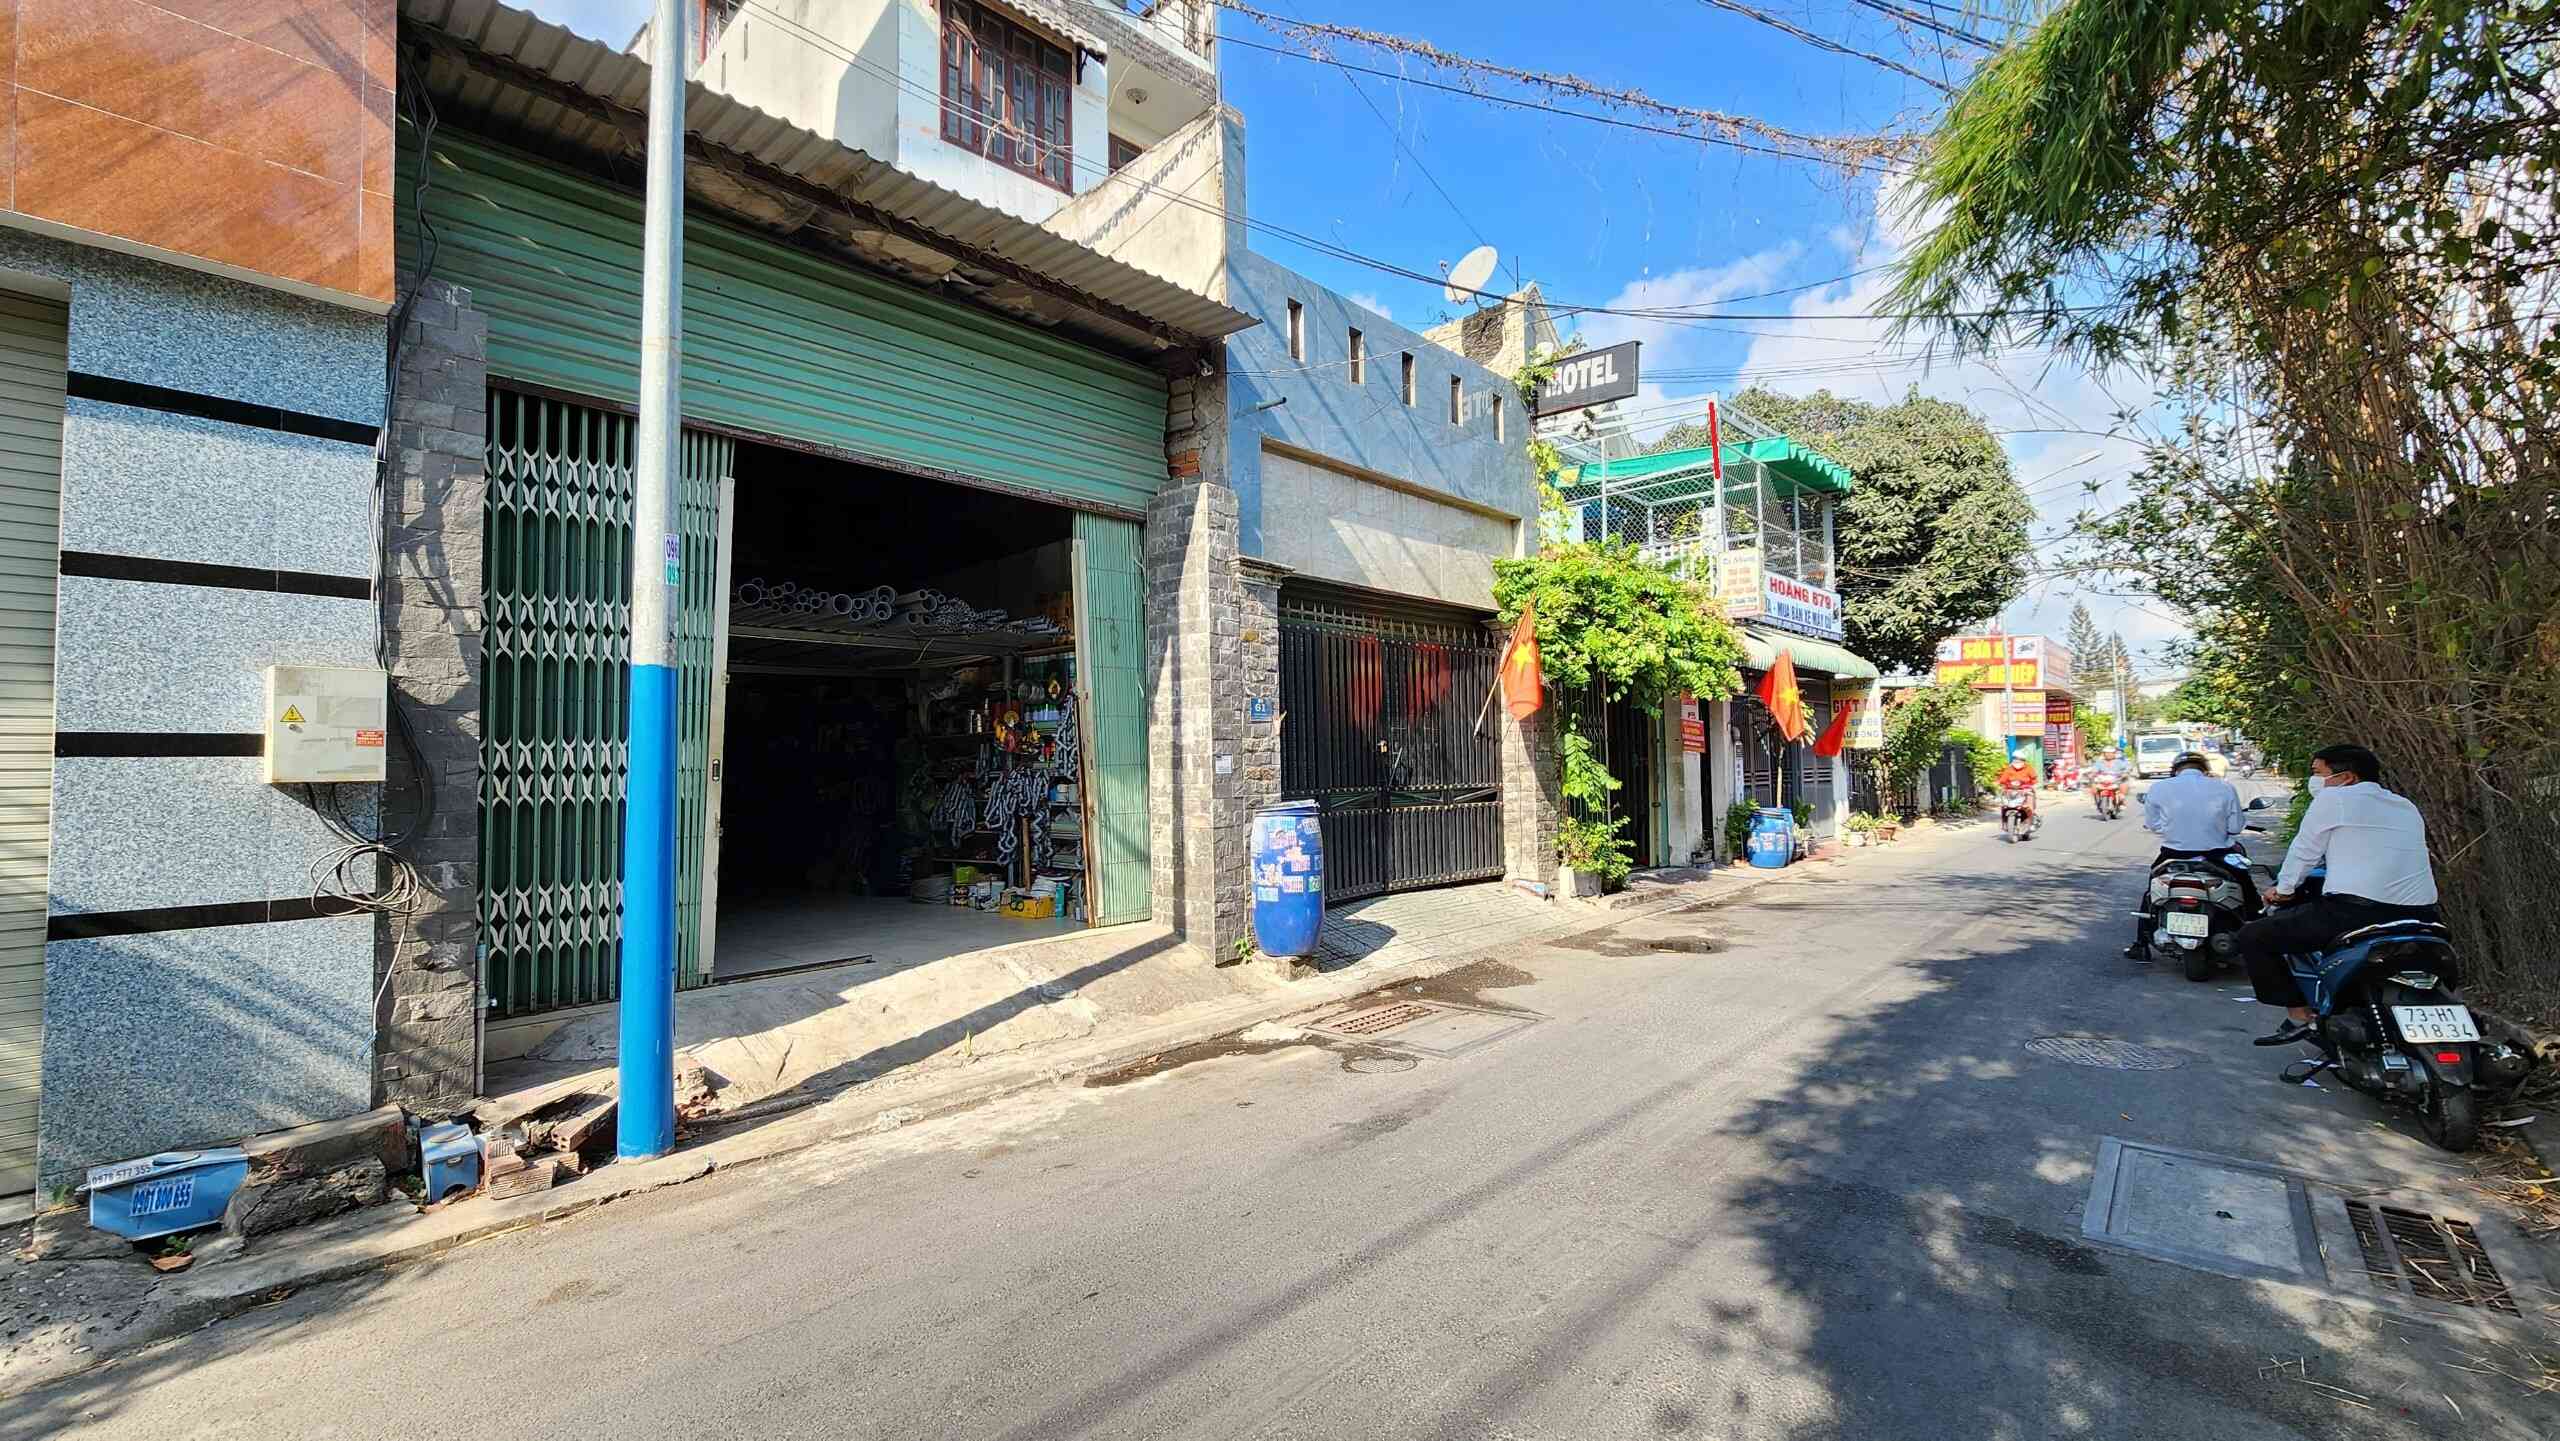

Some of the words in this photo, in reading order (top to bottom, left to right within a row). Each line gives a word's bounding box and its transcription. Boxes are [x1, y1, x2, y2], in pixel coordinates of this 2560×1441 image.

[1545, 352, 1619, 398] MOTEL
[1254, 703, 1267, 712] 61
[2404, 1008, 2456, 1022] 73-H1
[2405, 1023, 2473, 1038] 518.34
